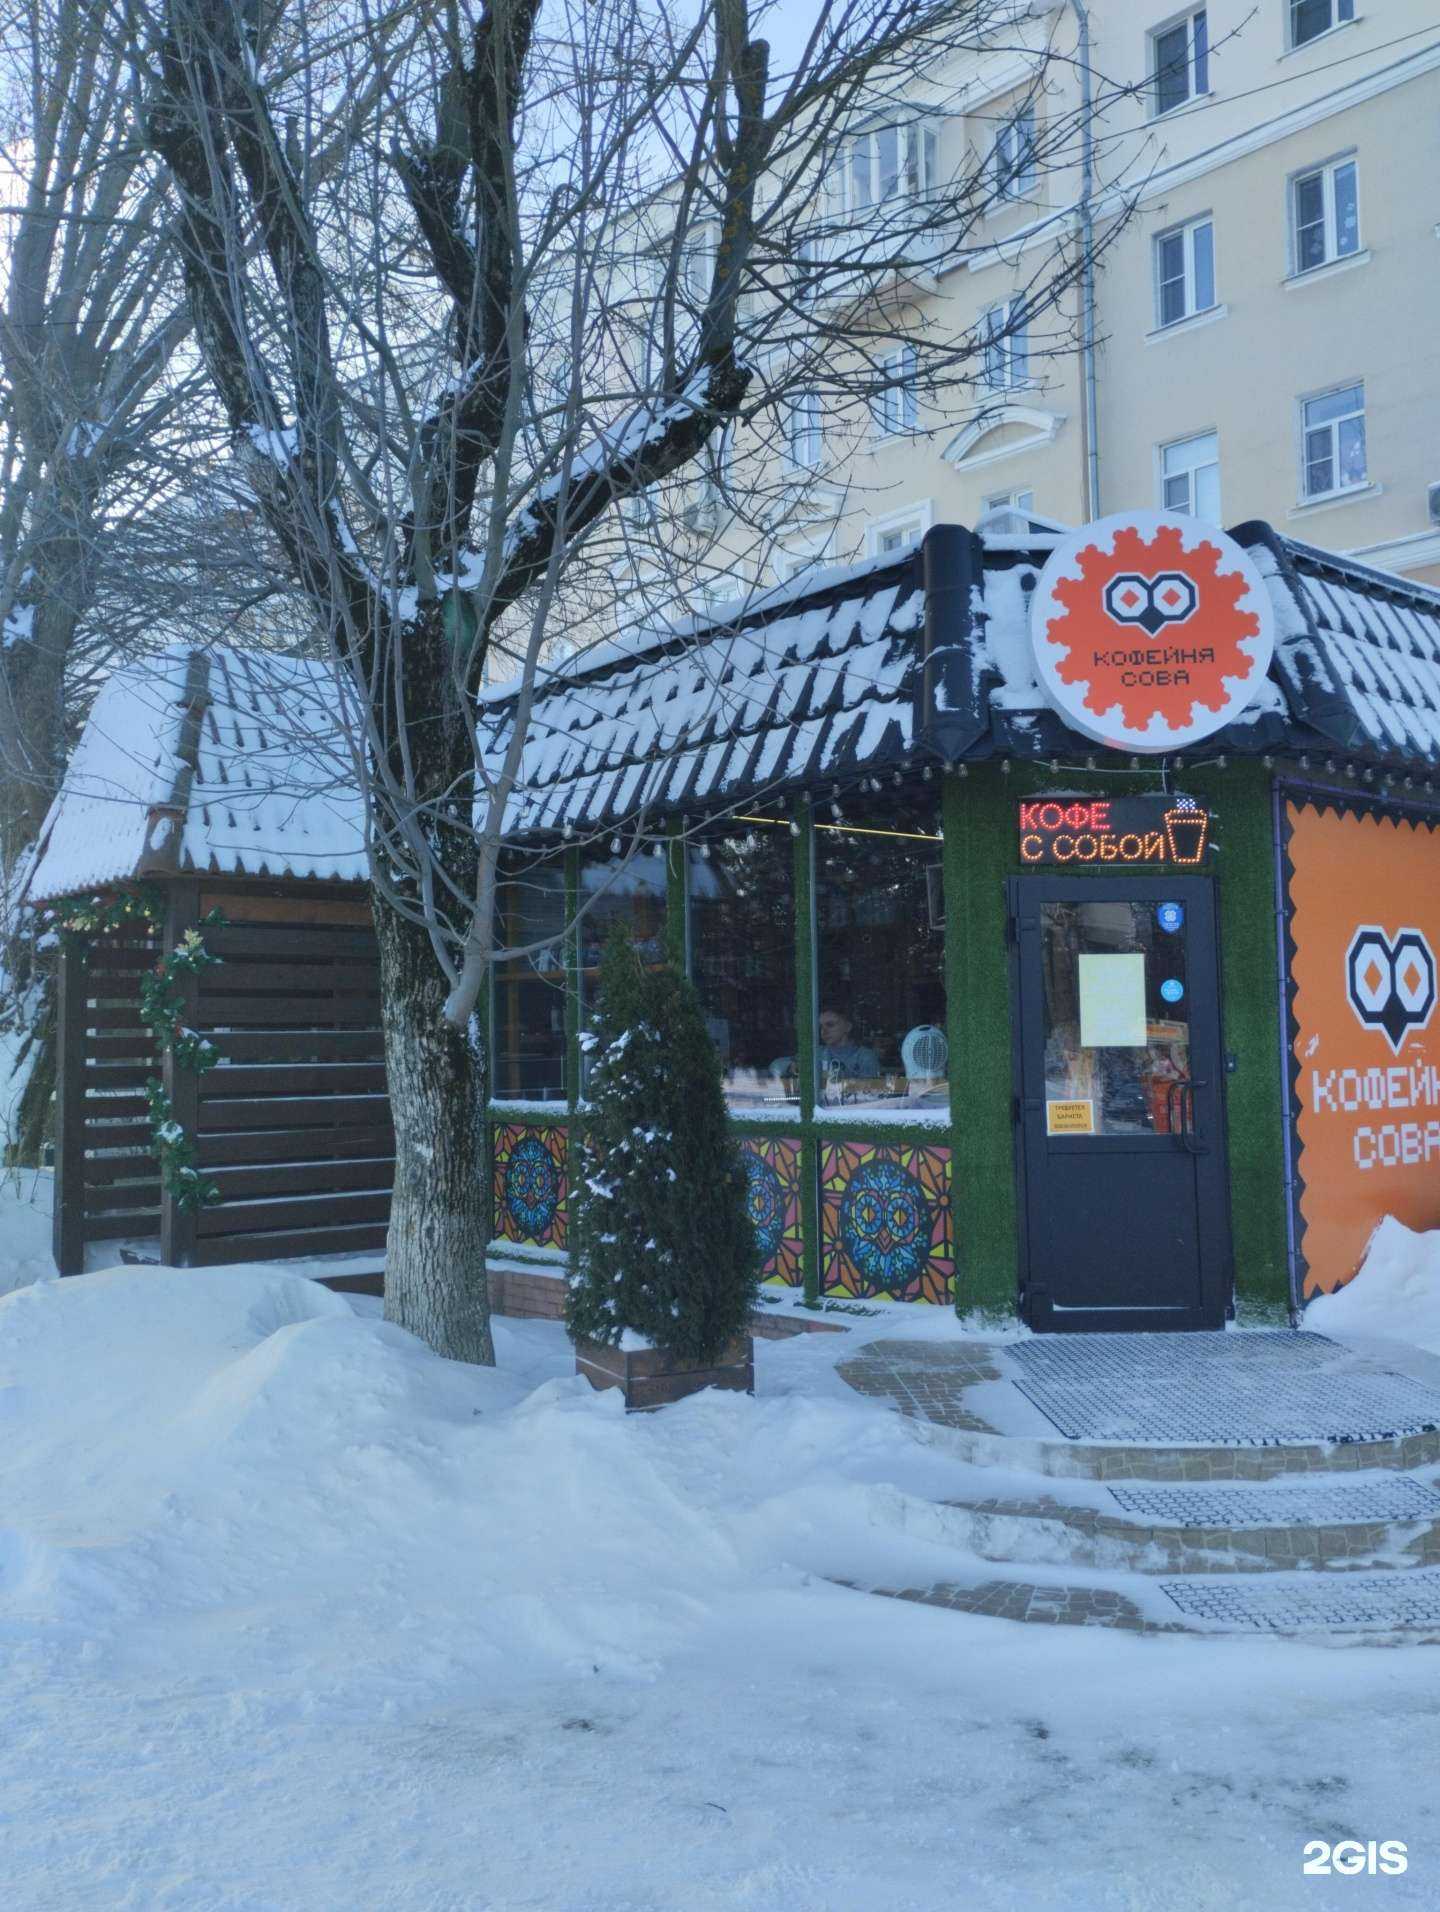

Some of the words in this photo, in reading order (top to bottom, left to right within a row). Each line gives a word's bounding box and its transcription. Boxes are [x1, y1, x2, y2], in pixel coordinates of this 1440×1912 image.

[1094, 646, 1214, 666] КОФЕЙНЯ
[1121, 670, 1190, 687] СОВА
[1020, 803, 1111, 830] КОФЕ
[1021, 834, 1043, 860] С
[1053, 832, 1165, 860] СОБОЙ
[1354, 1121, 1440, 1169] СОВА
